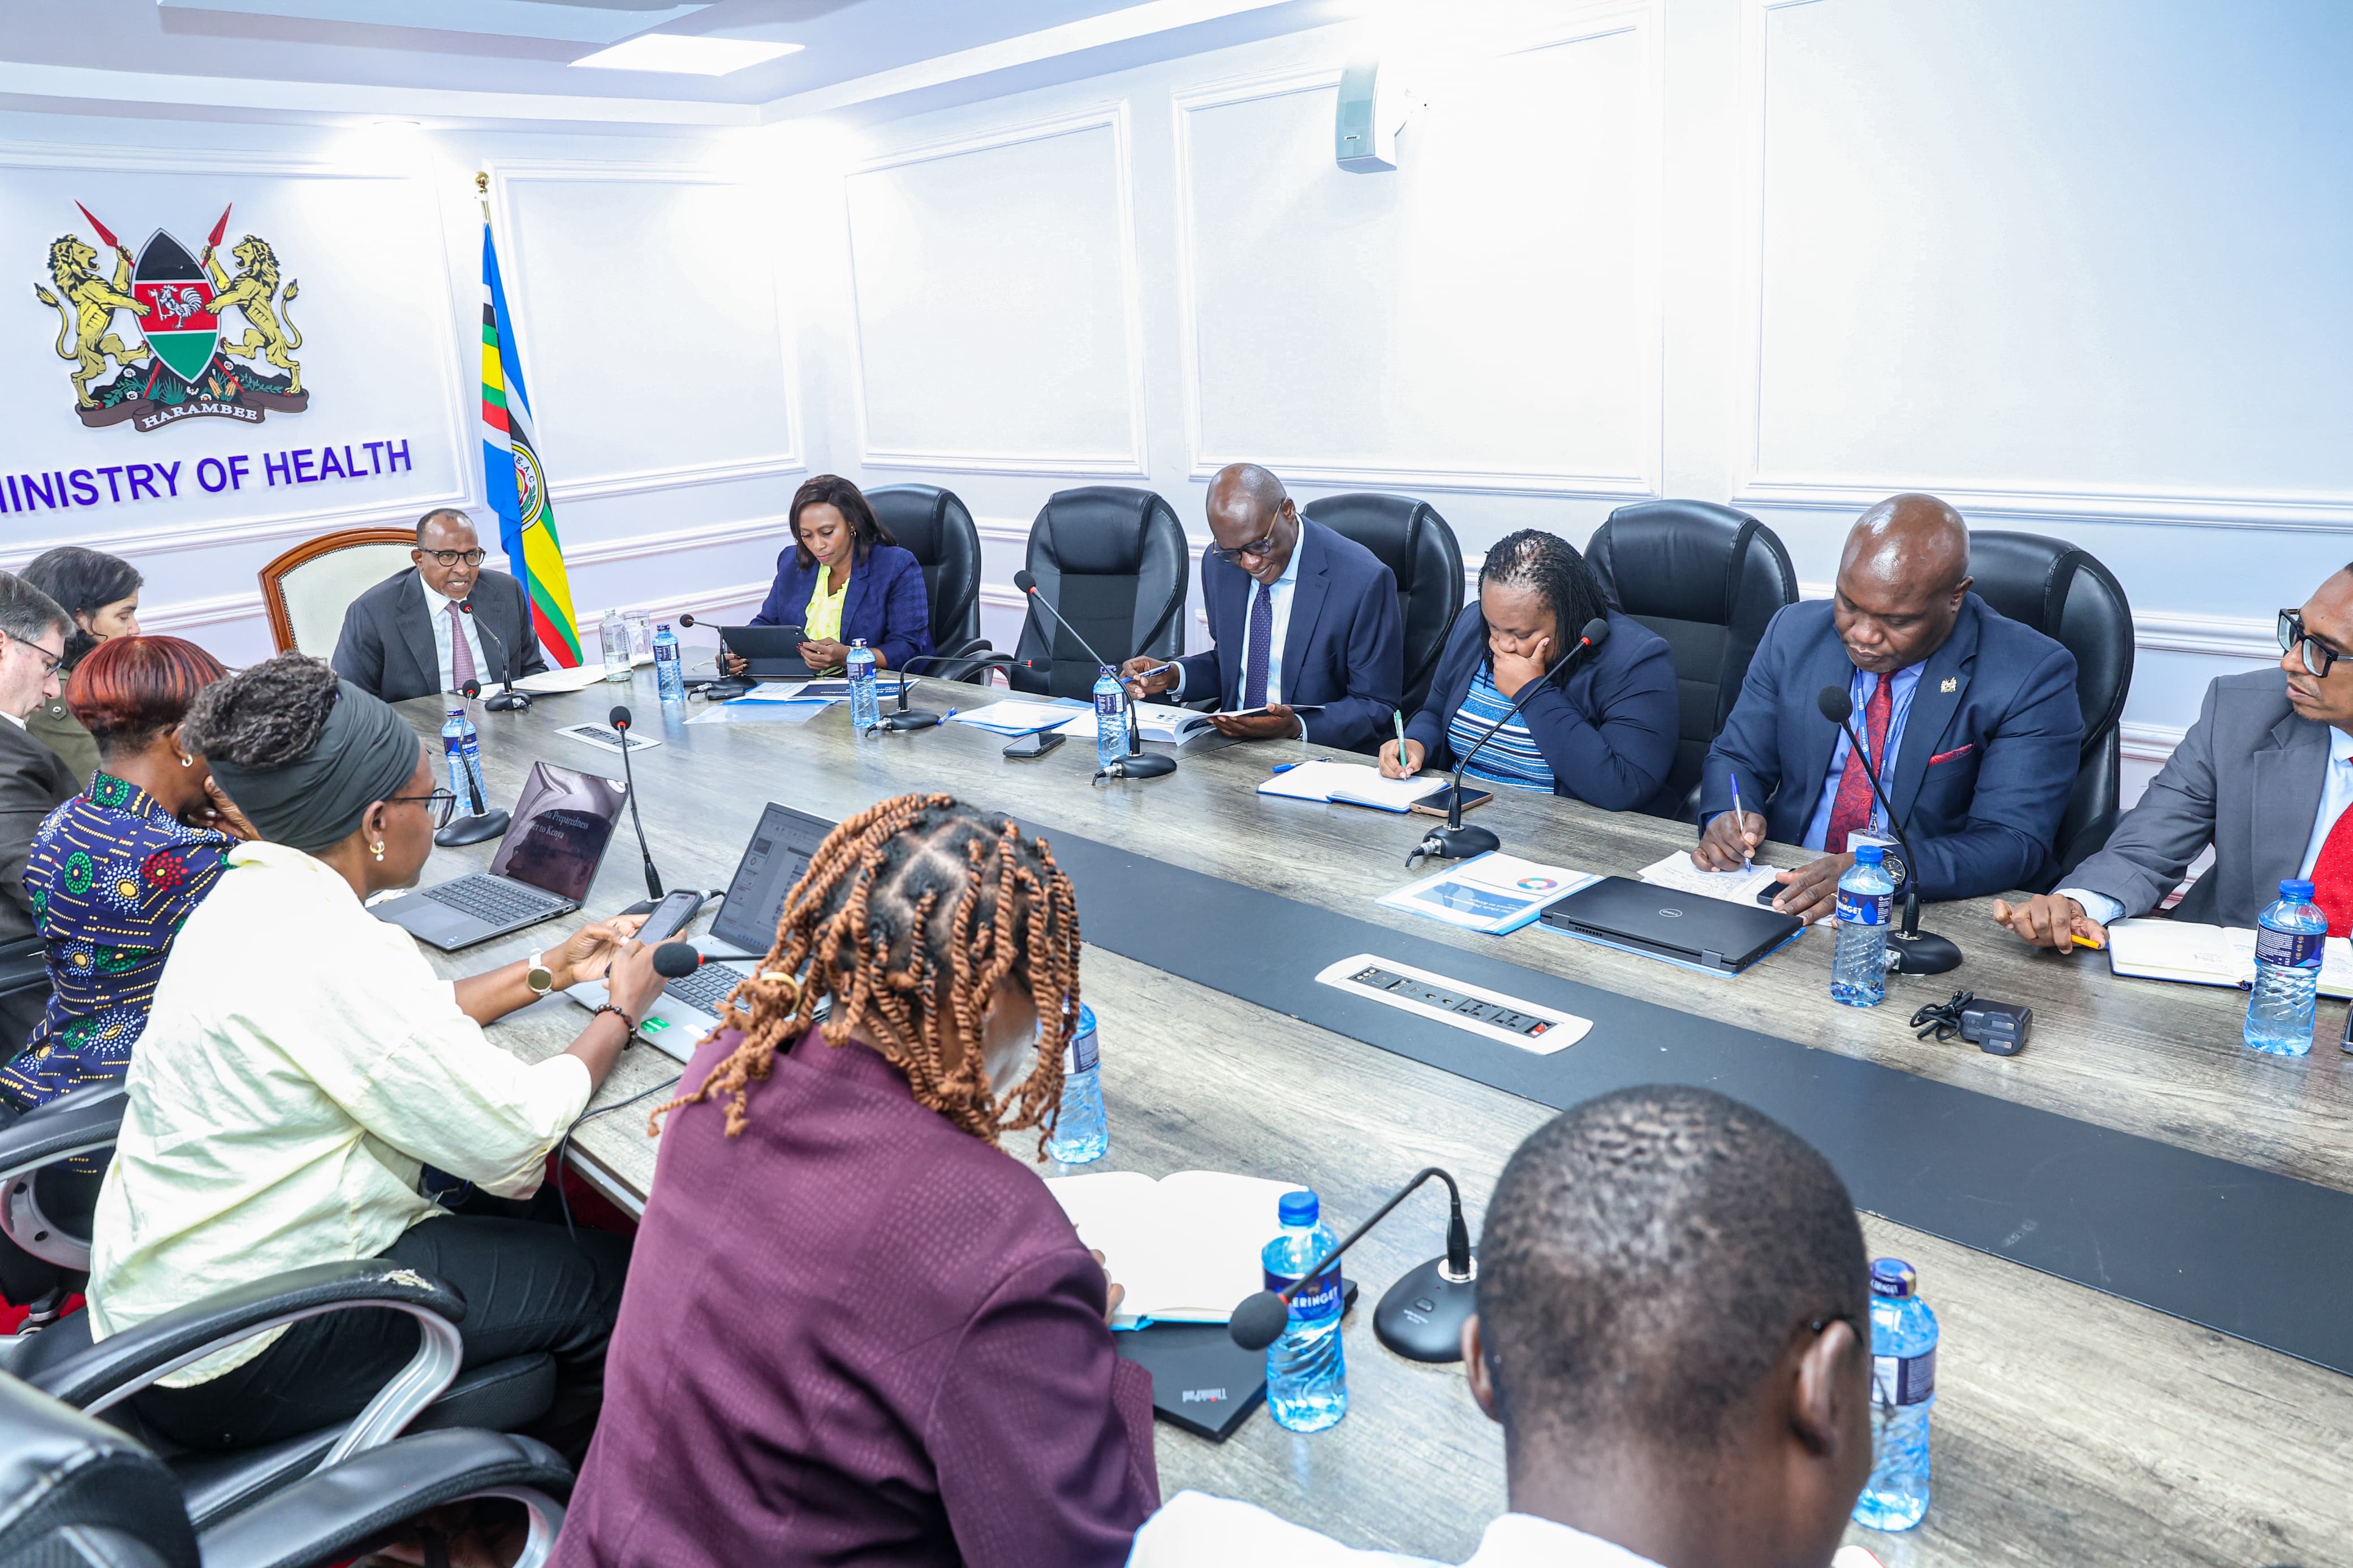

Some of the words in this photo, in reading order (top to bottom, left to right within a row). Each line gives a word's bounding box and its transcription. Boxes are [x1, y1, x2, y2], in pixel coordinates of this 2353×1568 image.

[141, 403, 257, 429] HARAMBEE
[0, 461, 181, 513] INISTRY
[197, 455, 249, 493] OF
[264, 439, 412, 486] HEALTH
[552, 811, 589, 830] Preparedness
[546, 825, 564, 840] Kenya
[1290, 1285, 1338, 1308] ERINGET
